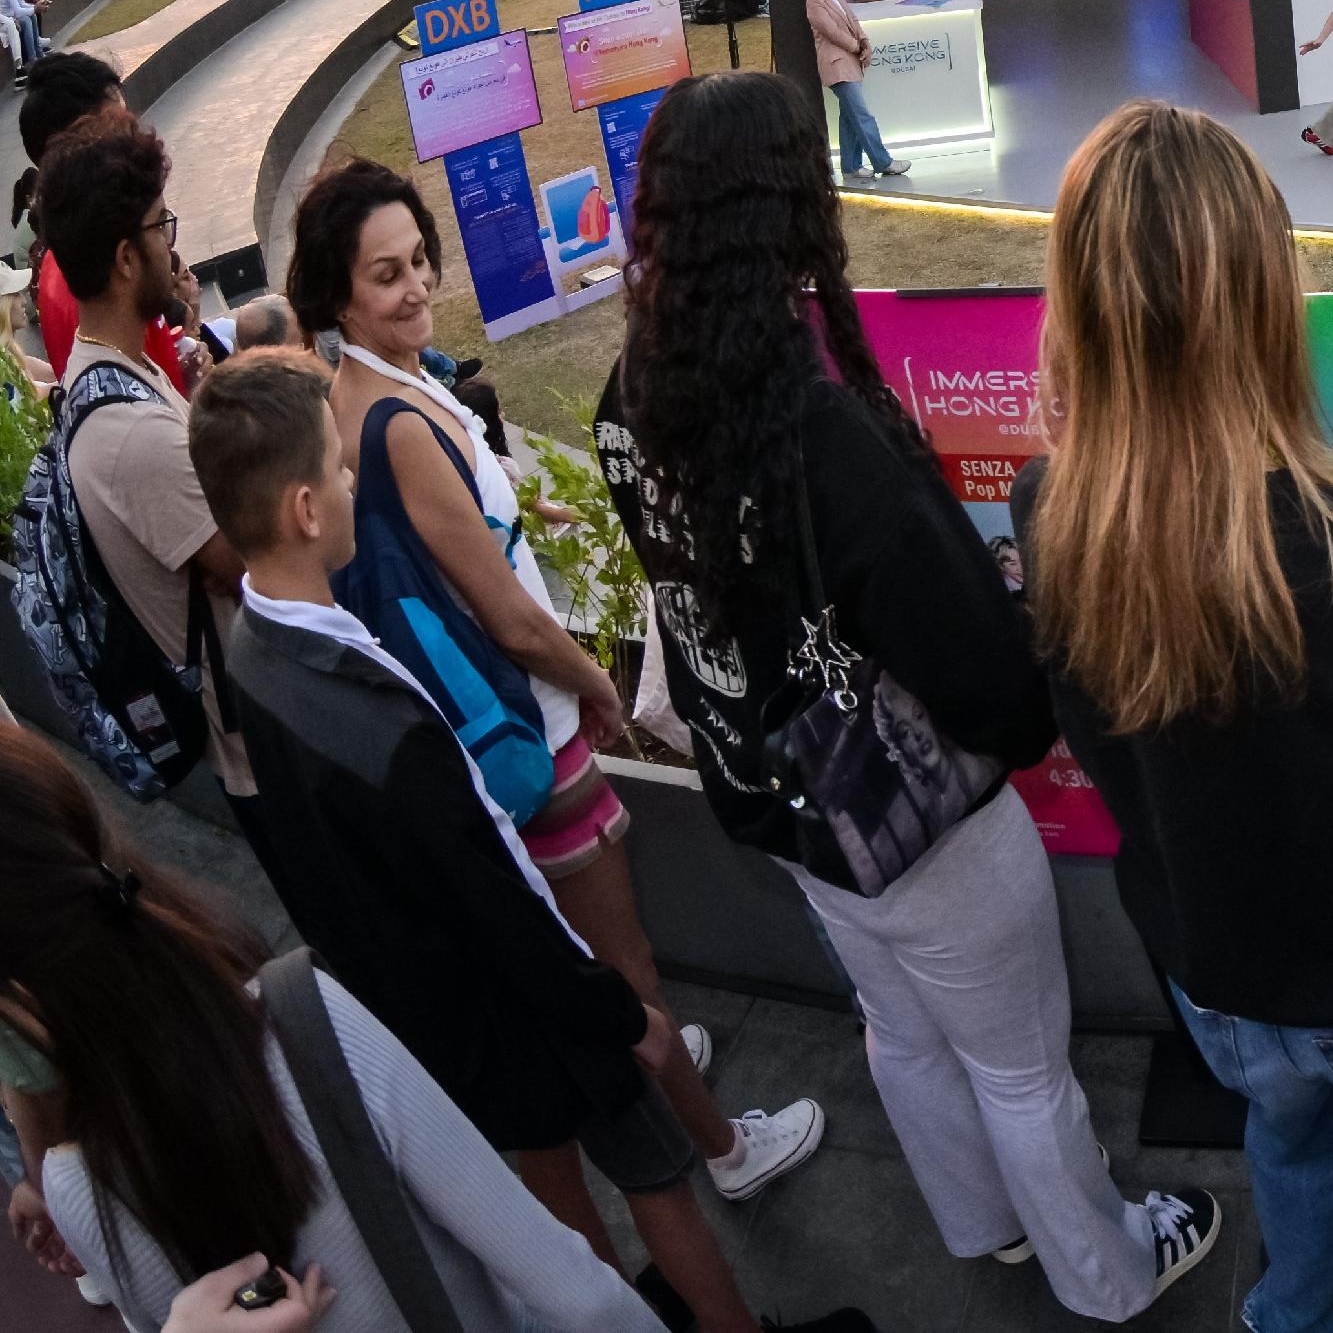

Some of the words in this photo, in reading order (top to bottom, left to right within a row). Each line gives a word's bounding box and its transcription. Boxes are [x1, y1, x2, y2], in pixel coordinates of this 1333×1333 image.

[425, 0, 492, 45] DXB
[871, 56, 902, 67] ONG
[929, 370, 1044, 392] IMMERS
[924, 396, 1020, 418] HONG
[960, 460, 1016, 477] SENZA
[964, 481, 996, 501] Pop
